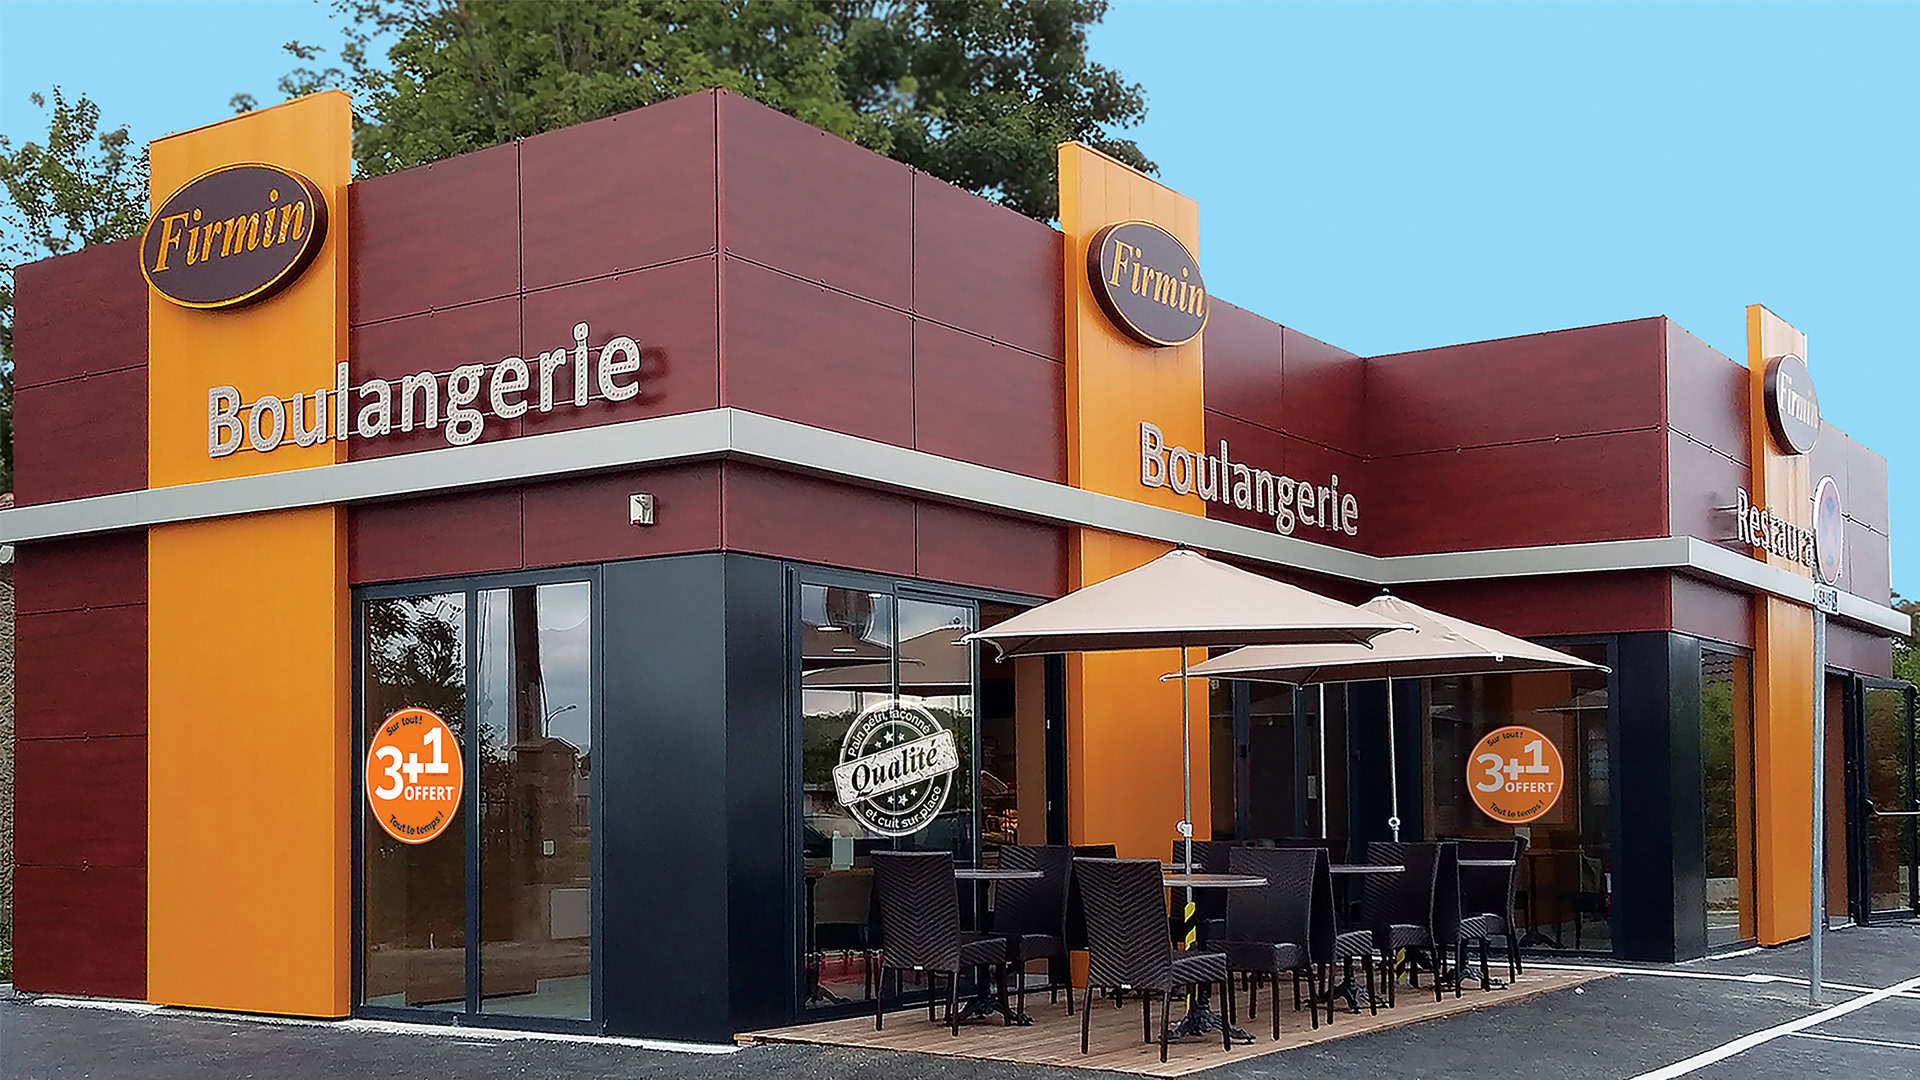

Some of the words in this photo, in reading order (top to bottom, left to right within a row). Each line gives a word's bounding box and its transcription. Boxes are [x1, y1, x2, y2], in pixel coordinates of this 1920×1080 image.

[151, 189, 306, 274] Firmin
[1108, 238, 1205, 318] Firmin
[207, 321, 642, 458] Boulangerie
[1780, 370, 1819, 429] Firmin
[1140, 420, 1359, 535] Boulangerie
[1737, 486, 1816, 567] Restaura
[386, 721, 399, 736] Sur
[848, 730, 865, 757] Pain
[890, 709, 931, 734] façonné
[1487, 735, 1500, 747] Sur
[851, 738, 938, 798] Qualité
[1505, 781, 1554, 793] OFFERT
[404, 785, 455, 801] OFFERT
[865, 808, 877, 822] et
[877, 814, 900, 828] cuit
[901, 812, 920, 827] sur
[918, 786, 942, 818] place
[1490, 801, 1506, 816] Tout
[390, 814, 405, 833] Tout
[406, 825, 415, 835] le
